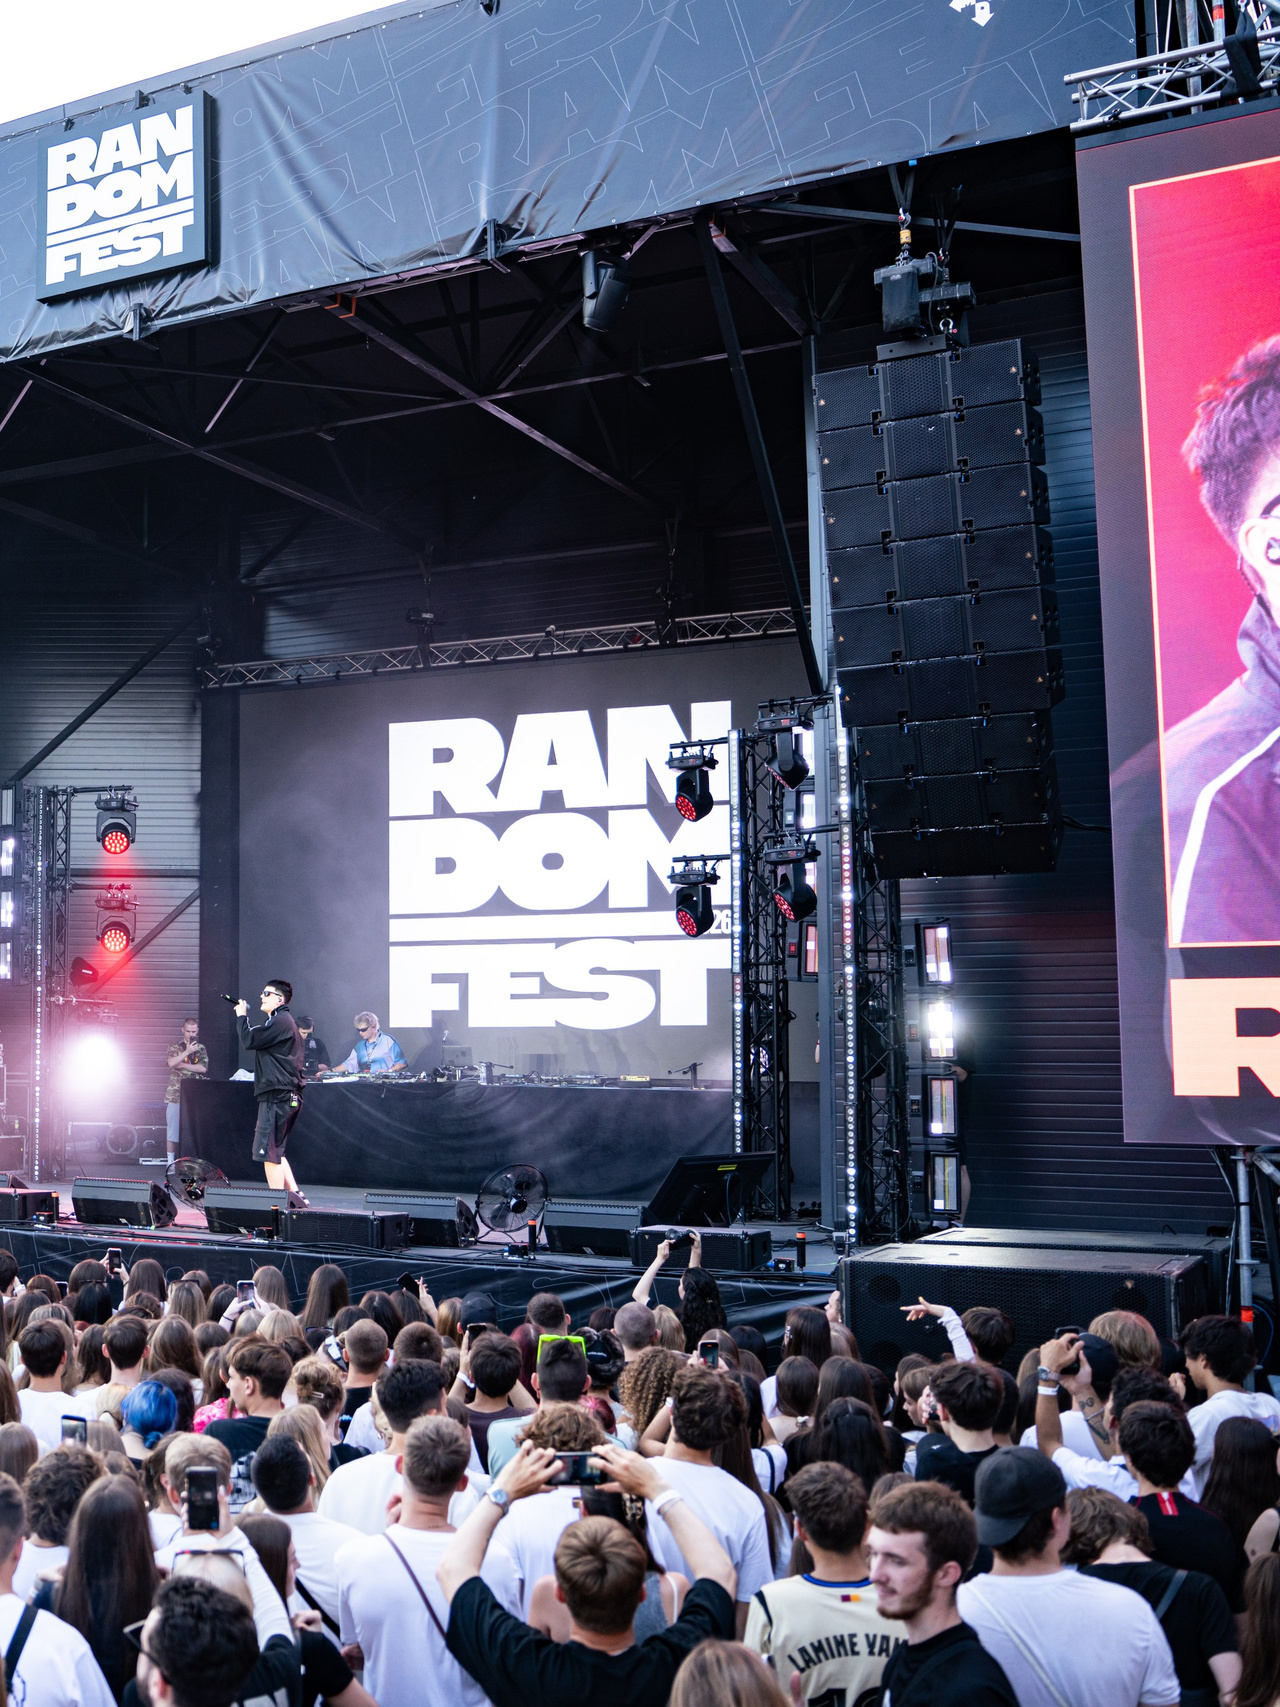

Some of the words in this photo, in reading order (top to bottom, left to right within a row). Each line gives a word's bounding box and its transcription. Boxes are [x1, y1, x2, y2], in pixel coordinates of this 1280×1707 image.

[47, 151, 194, 234] DOM
[48, 105, 193, 190] RAN
[46, 210, 194, 285] FEST
[389, 701, 732, 817] RAN
[389, 804, 732, 915] DOM
[389, 938, 732, 1030] FEST
[1170, 977, 1280, 1097] R
